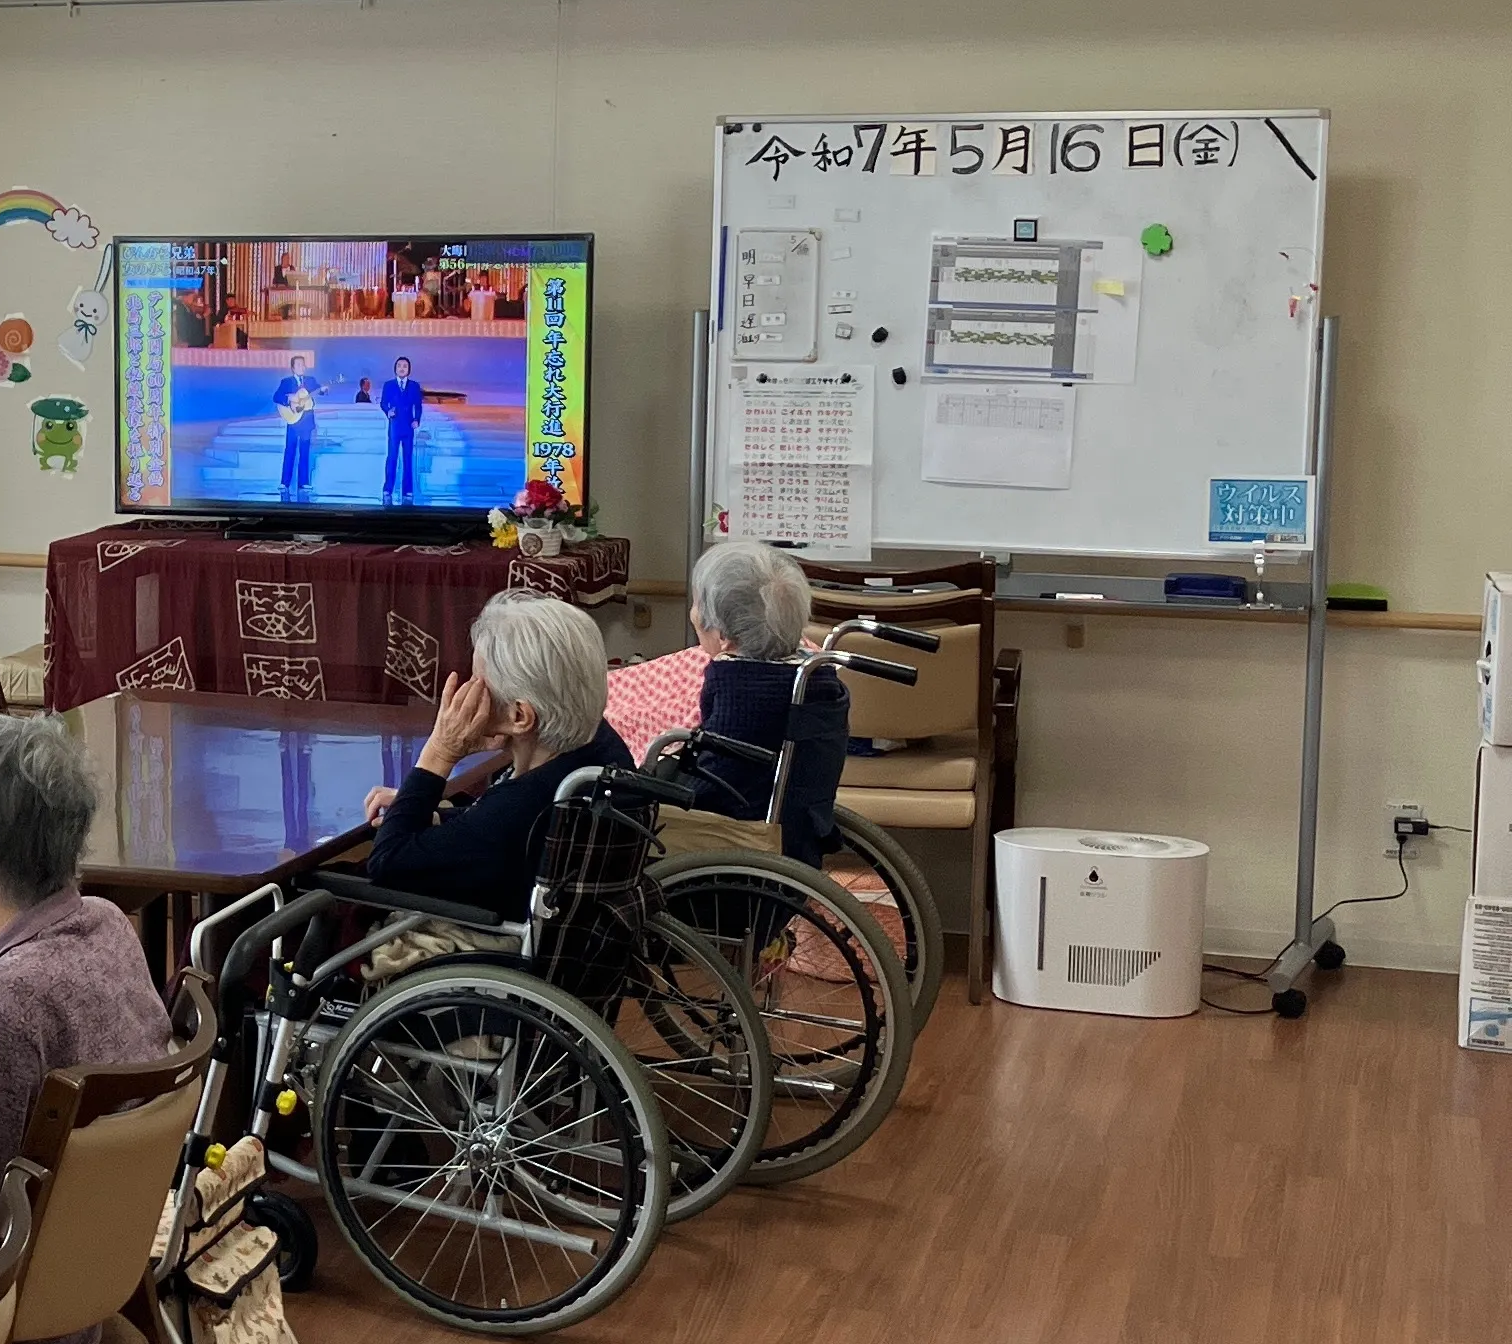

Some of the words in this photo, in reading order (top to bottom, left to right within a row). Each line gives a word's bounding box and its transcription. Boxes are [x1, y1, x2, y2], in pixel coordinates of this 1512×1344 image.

[741, 248, 756, 265] 明
[742, 274, 755, 289] 早
[742, 294, 755, 308] 日
[1217, 483, 1302, 504] ウイルス
[1222, 503, 1294, 526] 対策中
